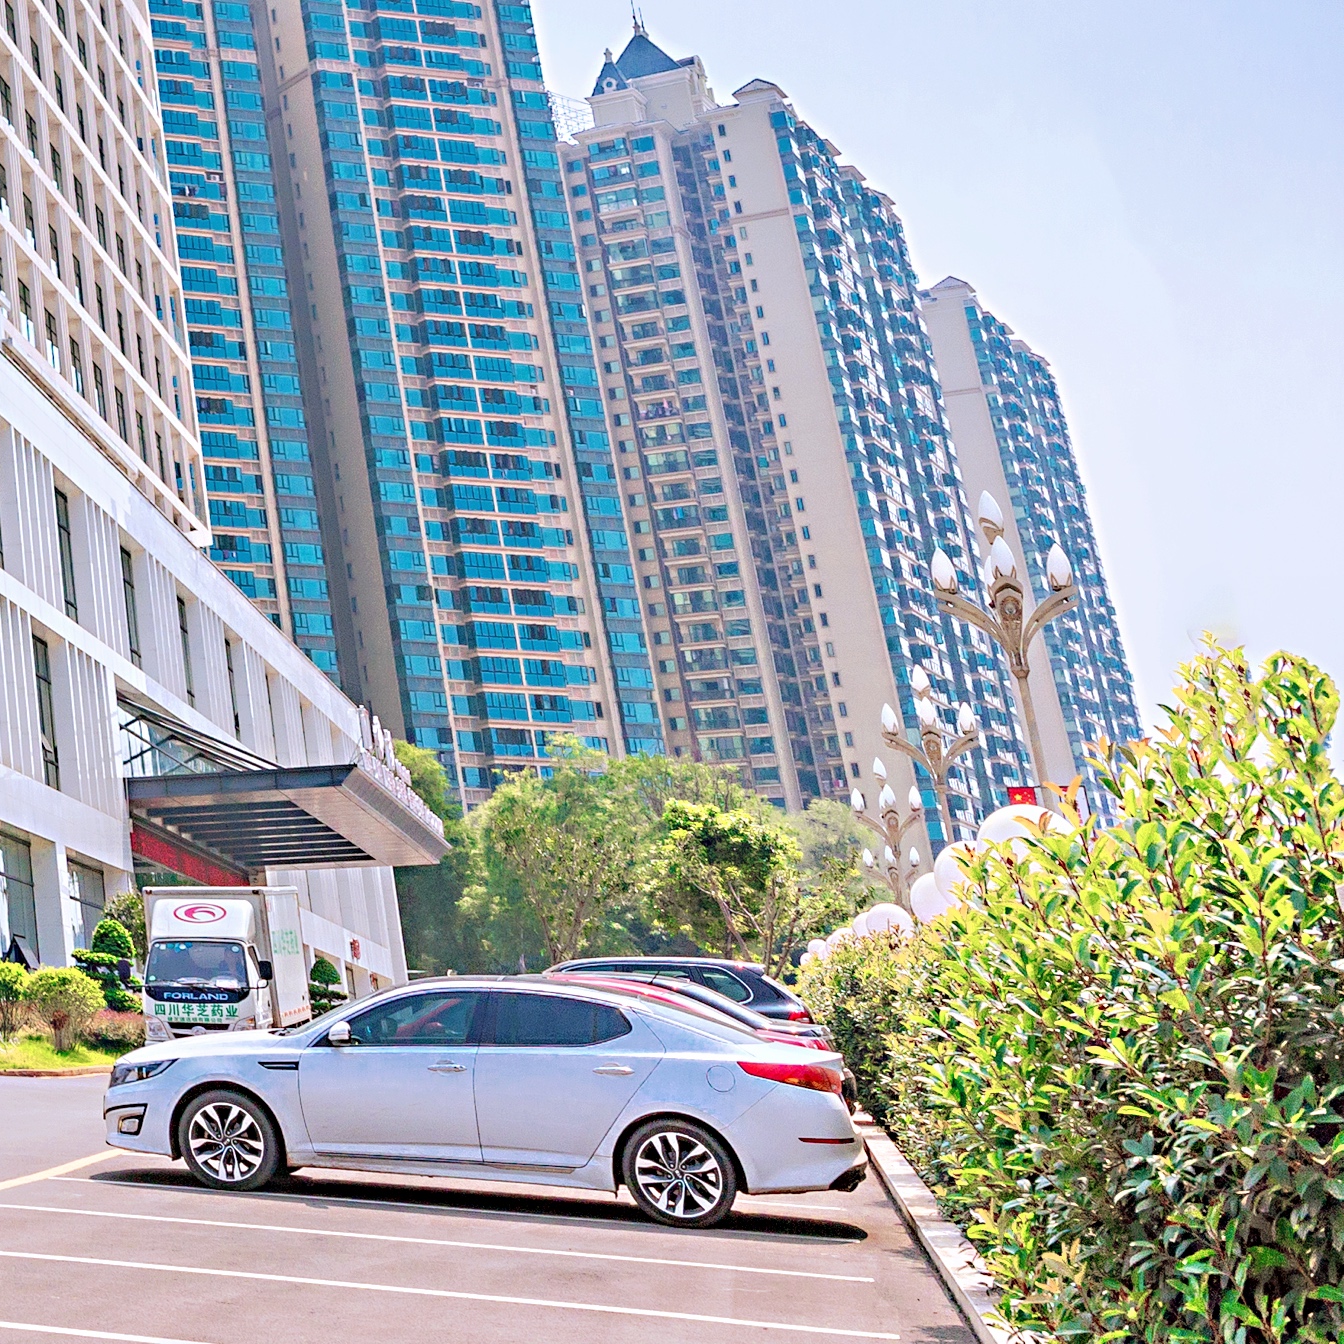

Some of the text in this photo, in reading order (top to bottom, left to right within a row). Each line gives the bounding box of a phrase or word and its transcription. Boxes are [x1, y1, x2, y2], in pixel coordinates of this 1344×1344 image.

[163, 992, 229, 1001] FORLAND
[154, 1003, 239, 1018] 四川华芝药业
